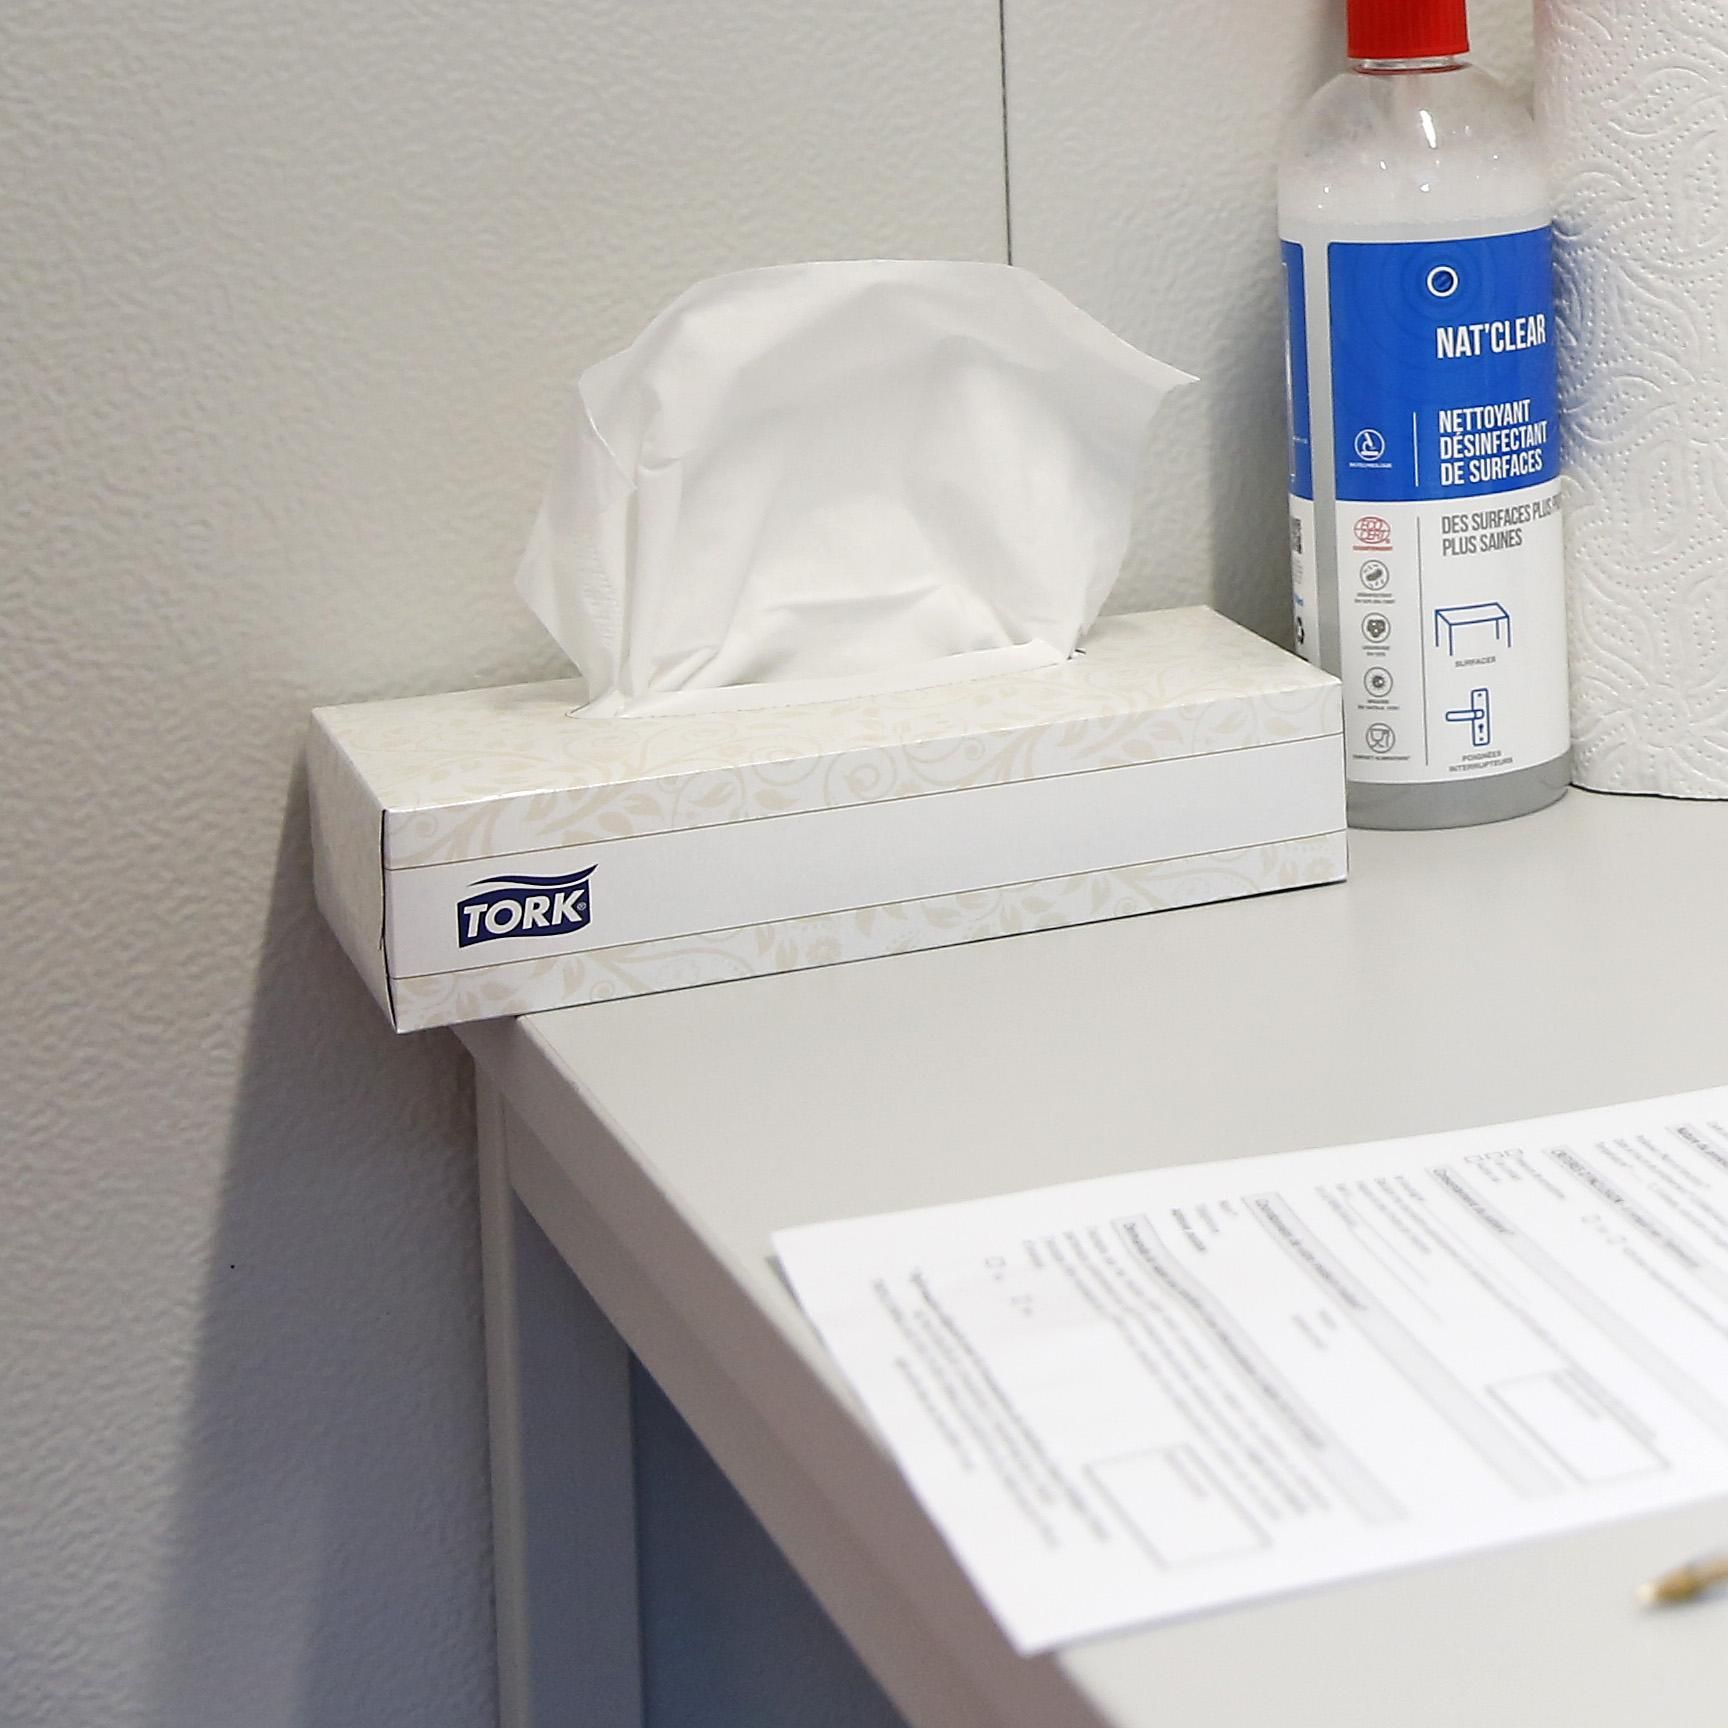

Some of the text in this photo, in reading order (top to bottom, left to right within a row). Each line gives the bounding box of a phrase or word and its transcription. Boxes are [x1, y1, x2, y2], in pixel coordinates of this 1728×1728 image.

[1436, 313, 1547, 360] NAT'CLEAR
[1438, 399, 1531, 433] NETTOYANT
[1440, 420, 1548, 460] DÉSINFECTANT
[1441, 450, 1543, 486] DE SURFACES
[1442, 513, 1469, 534] DES
[1472, 503, 1531, 531] SURFACES
[1532, 499, 1551, 521] PLUS
[1443, 528, 1523, 556] PLUS SAINES
[1455, 656, 1496, 668] SURFACES
[461, 887, 583, 939] TORK
